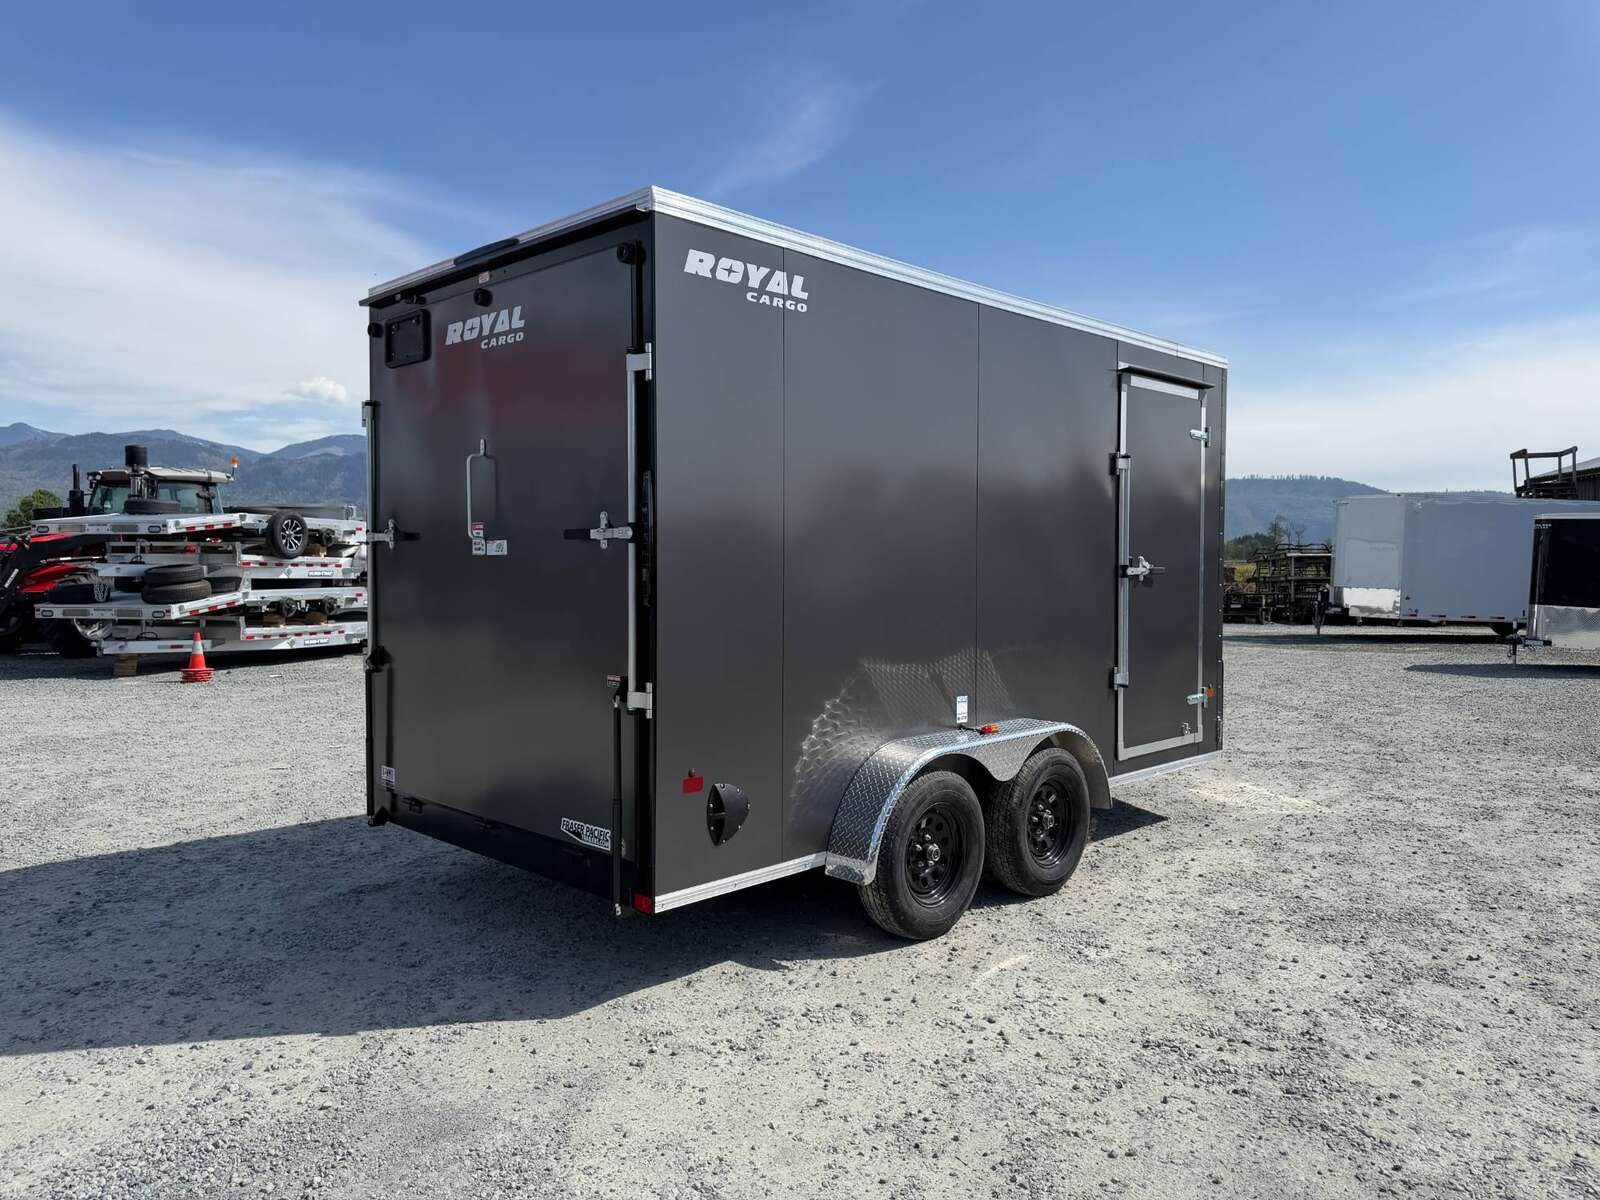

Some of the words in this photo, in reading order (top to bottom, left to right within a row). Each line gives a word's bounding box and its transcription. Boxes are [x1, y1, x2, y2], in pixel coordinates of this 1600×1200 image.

[684, 248, 809, 300] ROYAL
[746, 291, 808, 313] CARGO
[445, 305, 526, 346] ROYAL
[480, 331, 524, 349] CARGO
[561, 818, 584, 834] FRASER
[585, 824, 610, 842] PACIFIC
